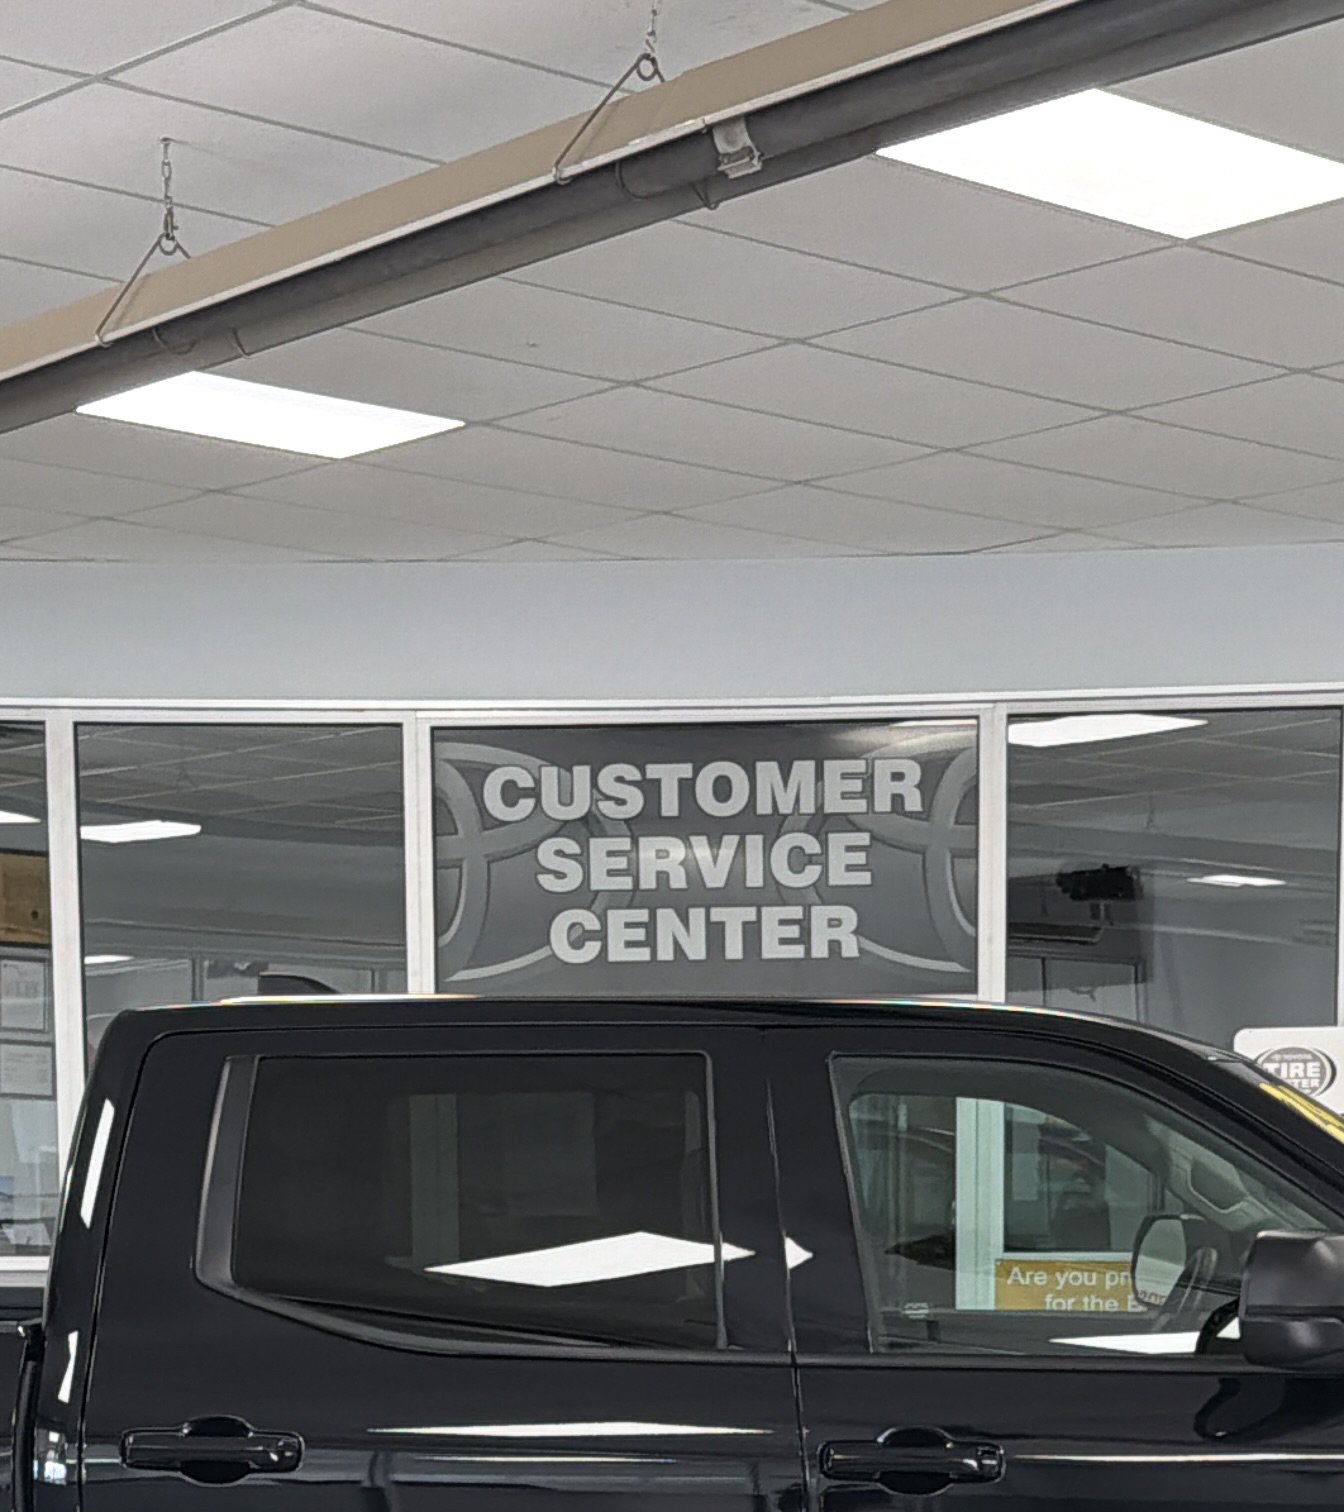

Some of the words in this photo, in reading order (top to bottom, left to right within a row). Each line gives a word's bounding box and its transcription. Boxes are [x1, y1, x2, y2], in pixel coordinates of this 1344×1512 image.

[483, 758, 924, 821] CUSTOMER
[536, 832, 872, 893] SERVICE
[550, 904, 860, 963] CENTER
[1262, 1062, 1321, 1078] TIRE
[1006, 1266, 1048, 1286] Are
[1055, 1270, 1097, 1290] you
[1044, 1294, 1076, 1311] for
[1083, 1294, 1120, 1311] the
